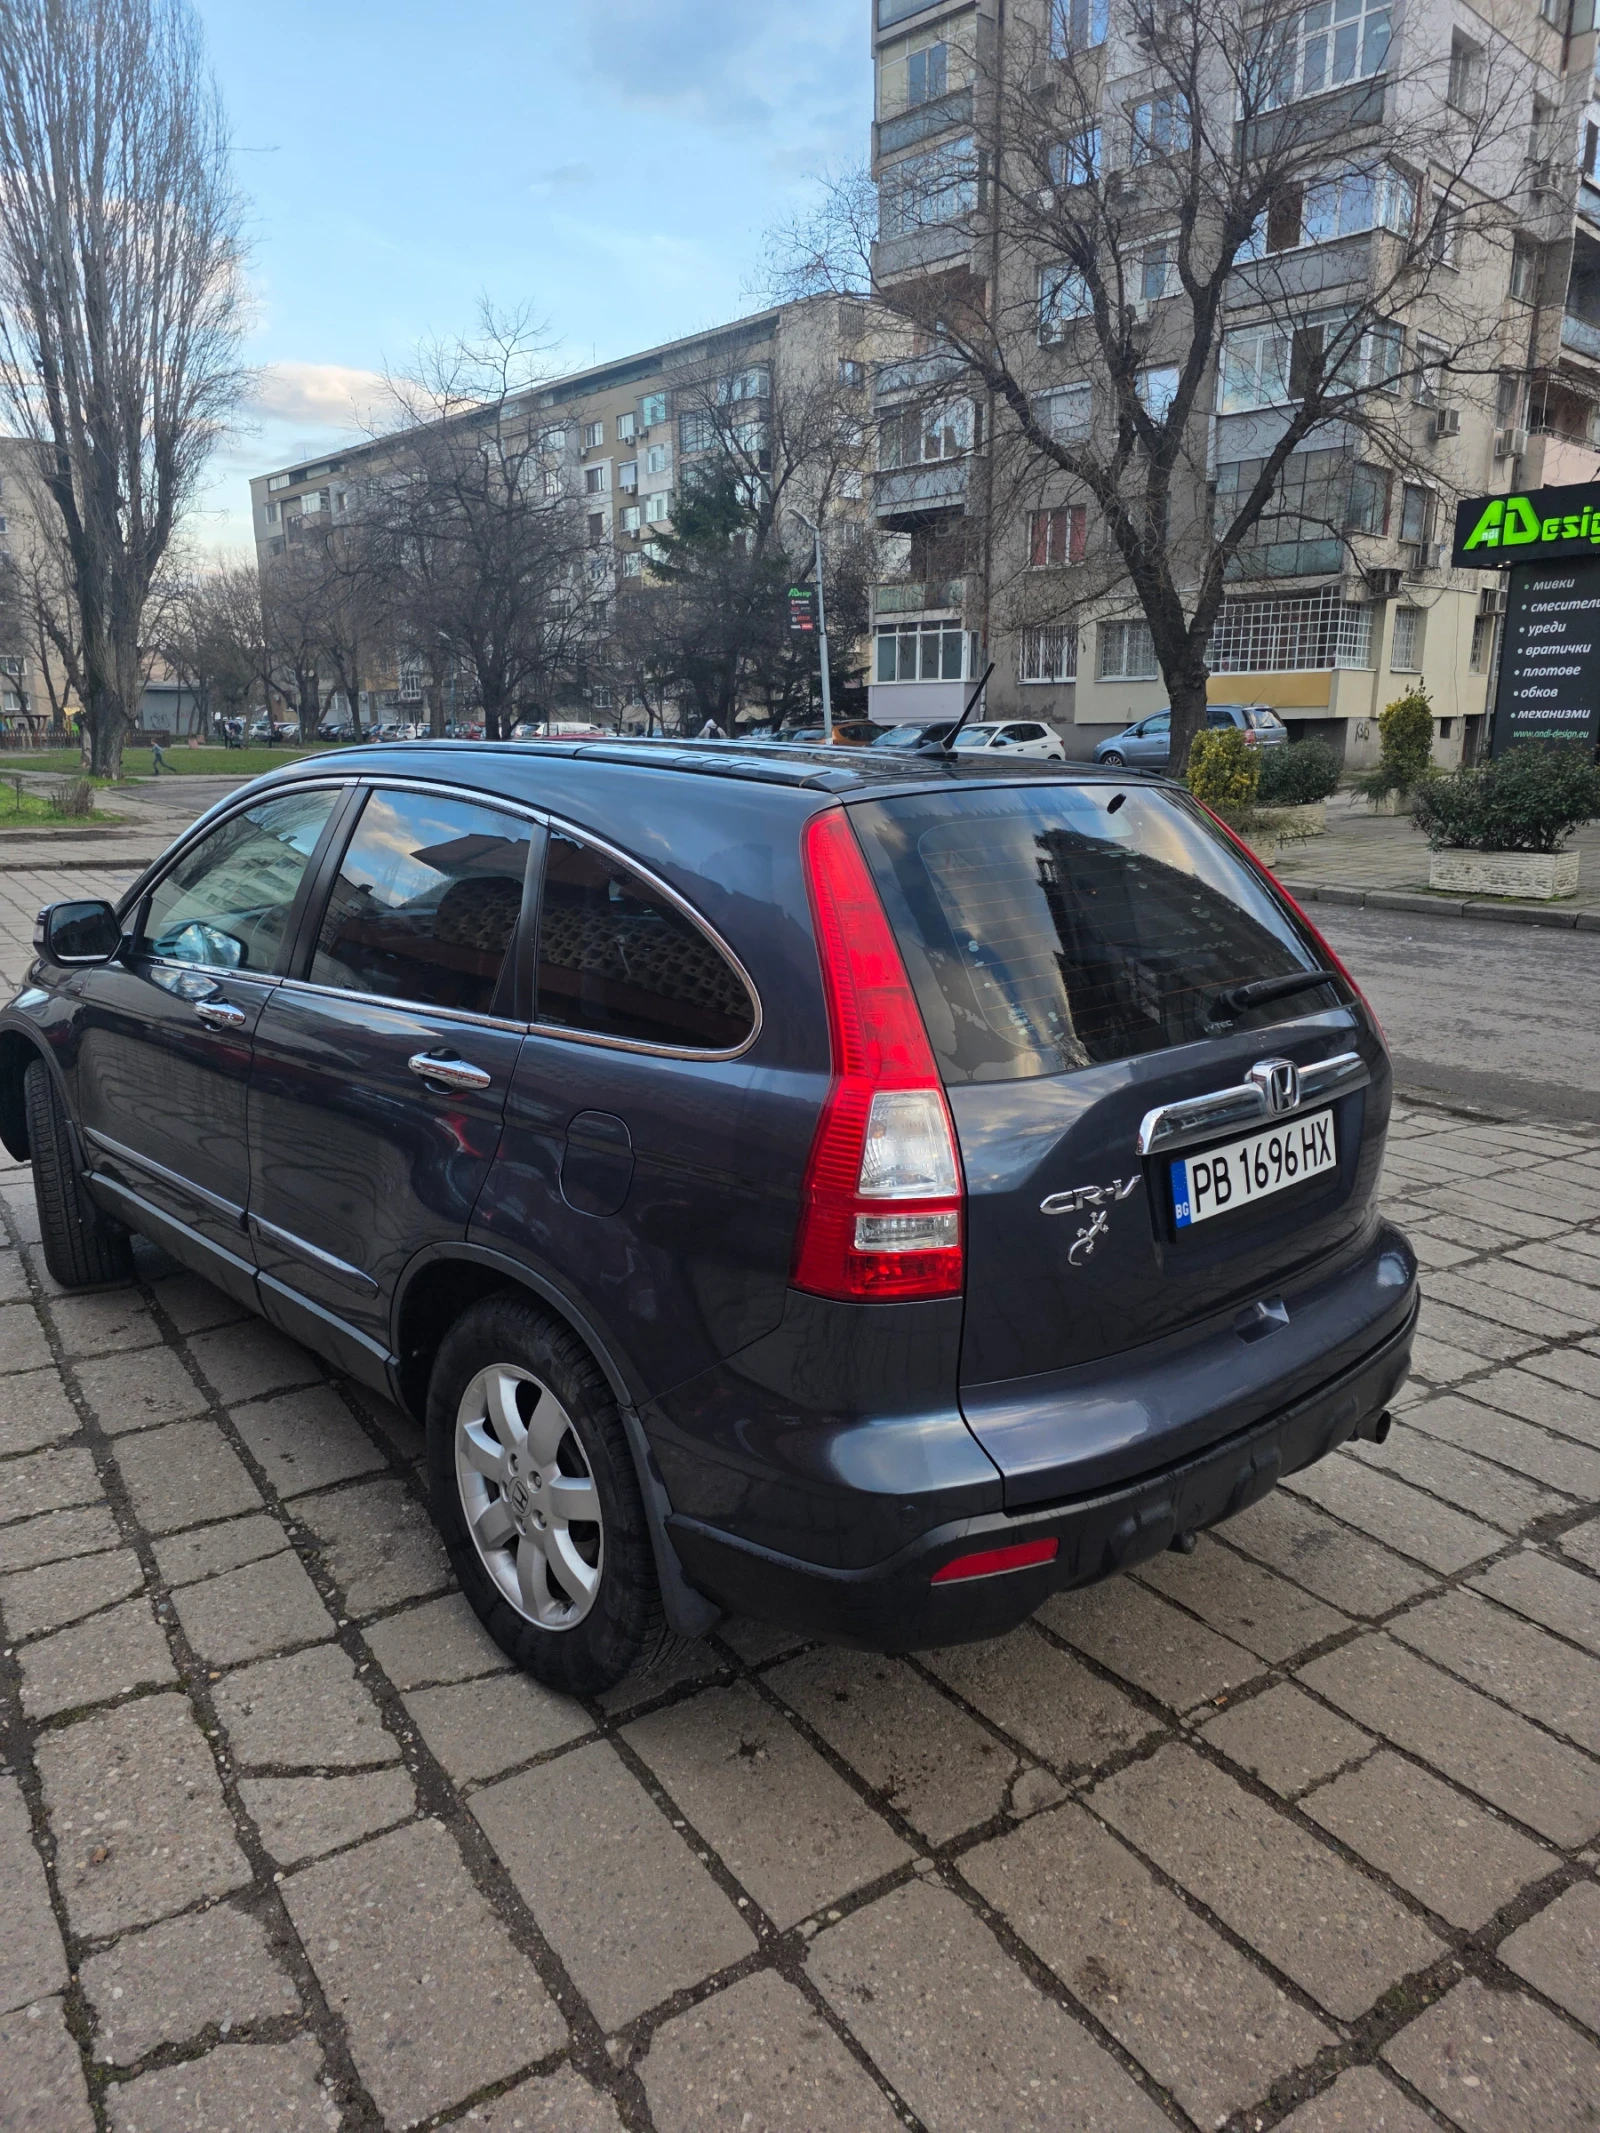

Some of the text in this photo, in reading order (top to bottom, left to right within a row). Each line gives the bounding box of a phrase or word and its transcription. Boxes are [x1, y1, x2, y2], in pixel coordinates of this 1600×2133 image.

[1532, 578, 1575, 591] мивки
[1528, 620, 1566, 637] уреди
[1525, 643, 1592, 658] вратички
[1522, 665, 1581, 677] плотове
[1520, 686, 1558, 698] обков
[1517, 709, 1591, 719] механизми
[1513, 729, 1589, 740] www.andi-design.eu
[1192, 1117, 1332, 1214] PB 1696 HX
[1040, 1174, 1141, 1214] CR-V
[1175, 1201, 1190, 1220] BG
